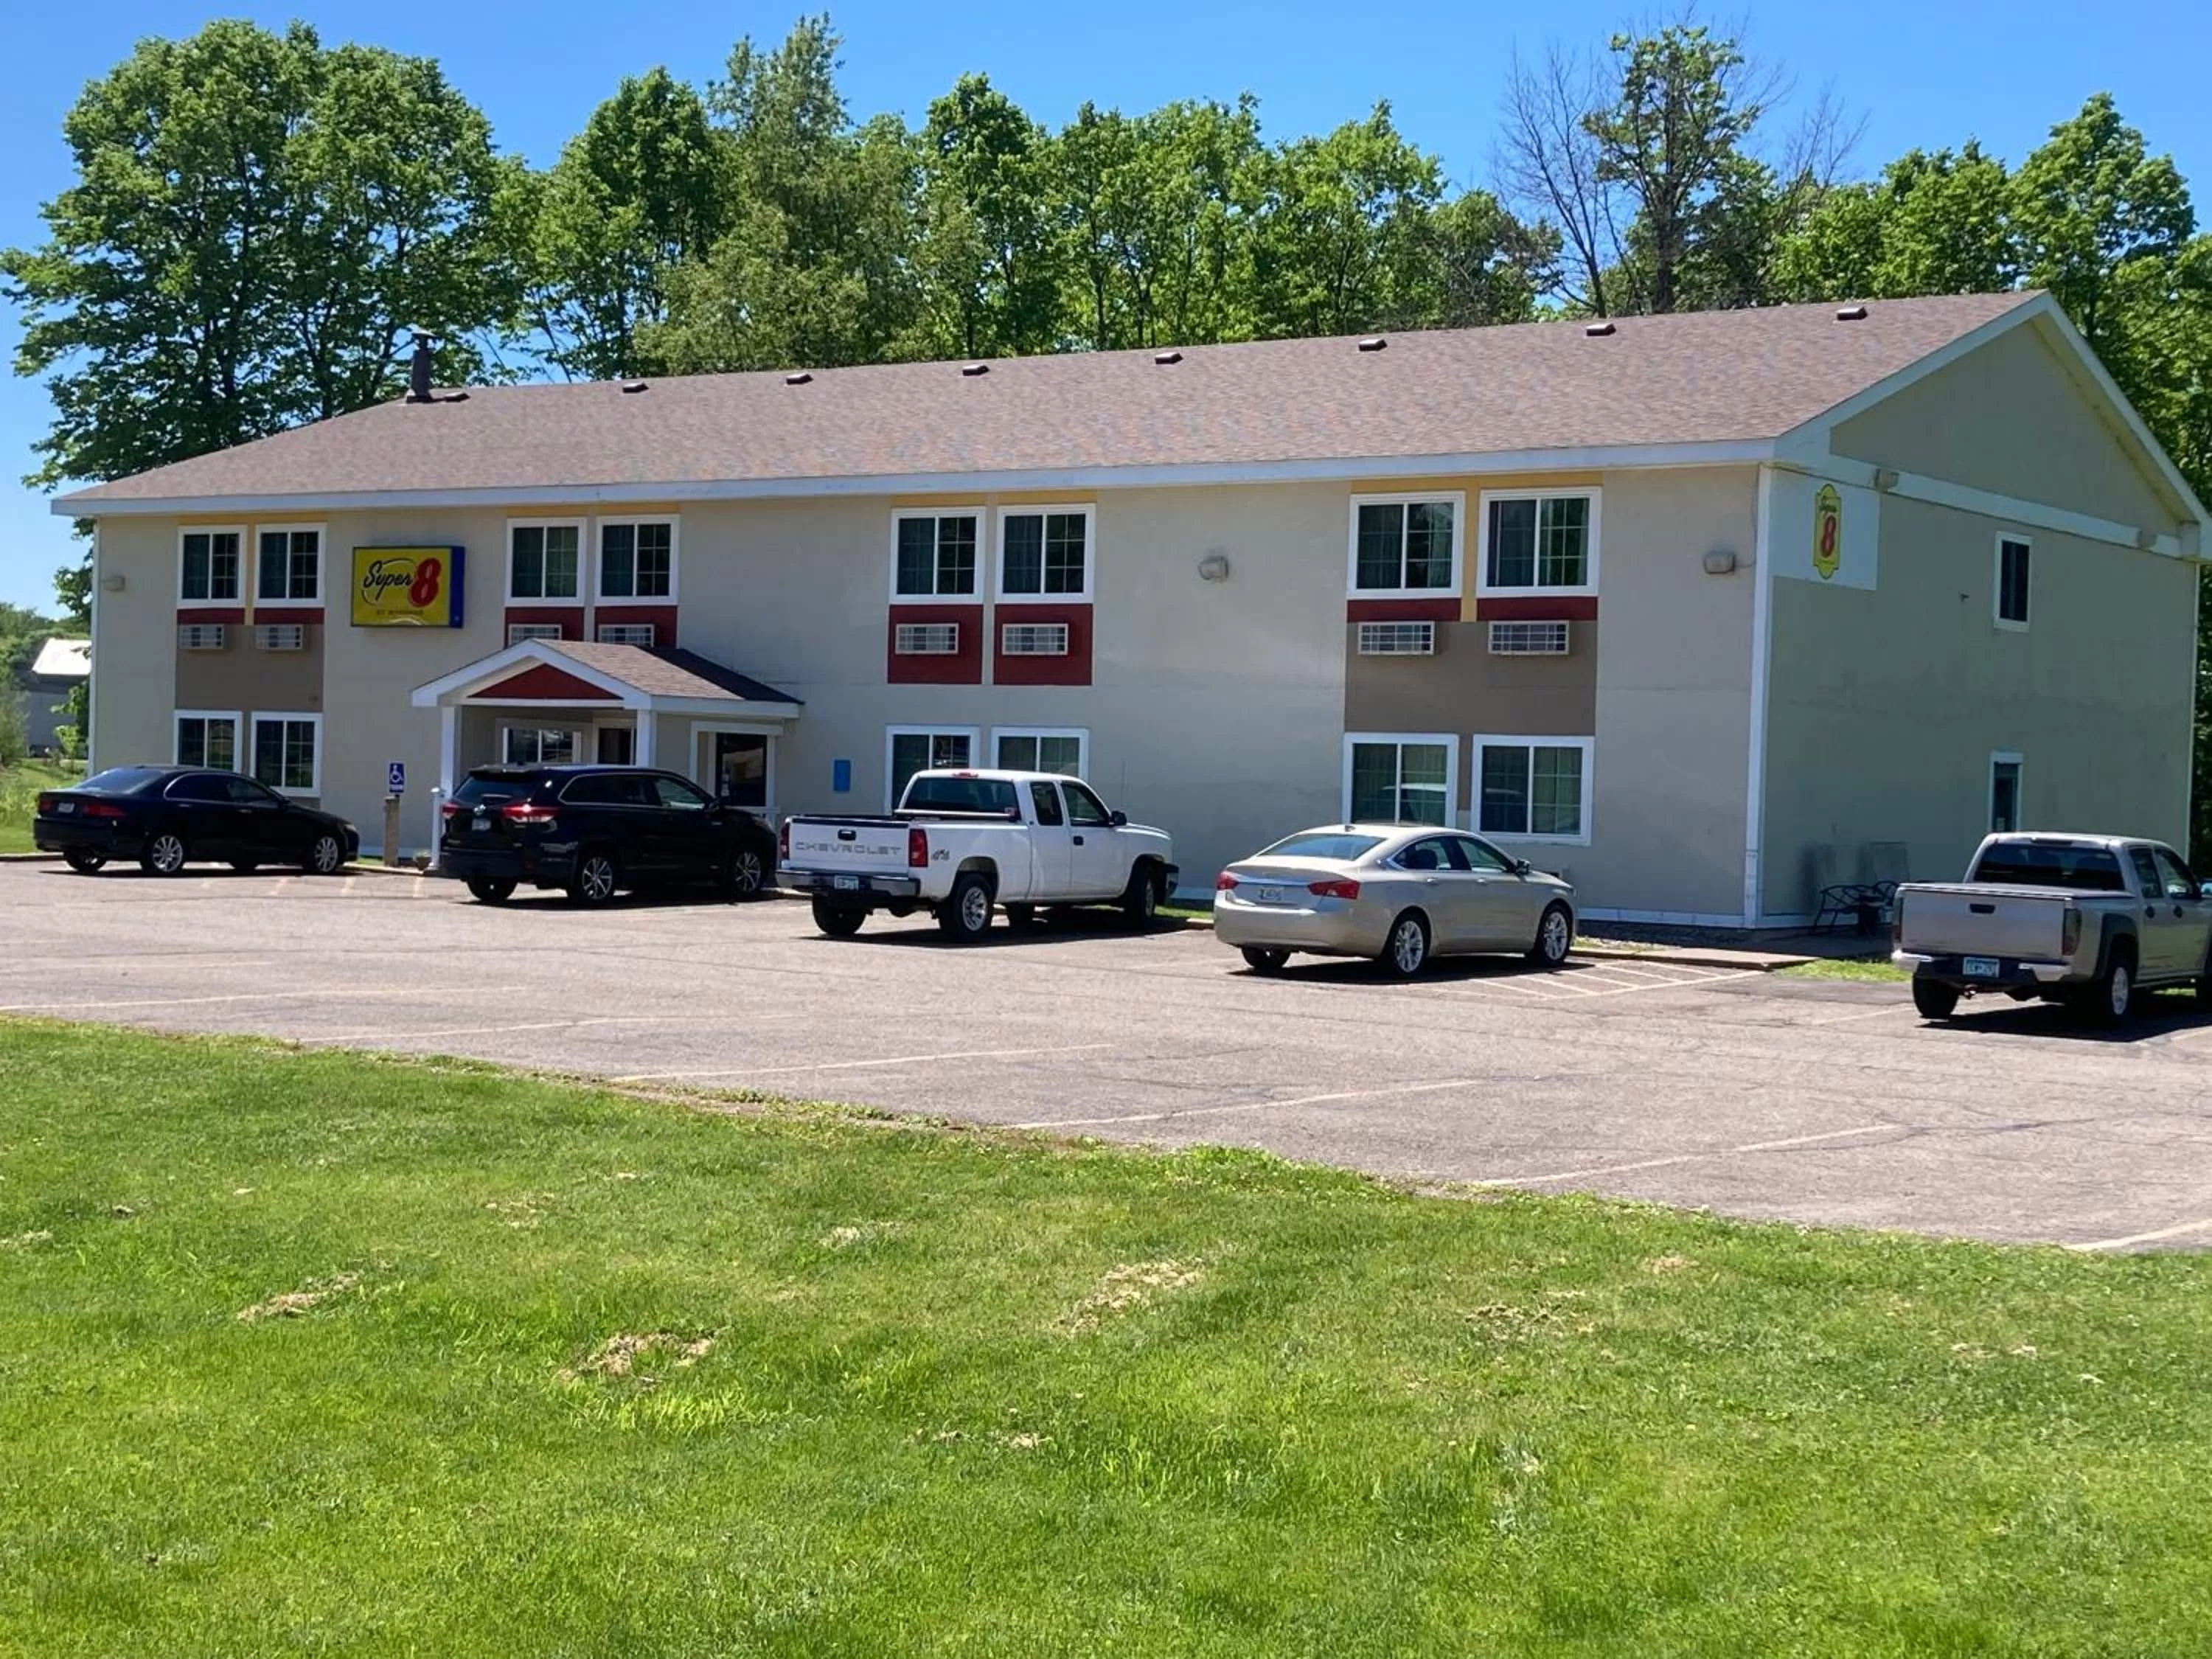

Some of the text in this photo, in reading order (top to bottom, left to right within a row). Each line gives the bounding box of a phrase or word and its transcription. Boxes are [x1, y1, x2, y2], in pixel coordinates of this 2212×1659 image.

[1820, 515, 1836, 558] 8
[363, 557, 442, 608] Super 8
[796, 841, 902, 855] CHEVROLET
